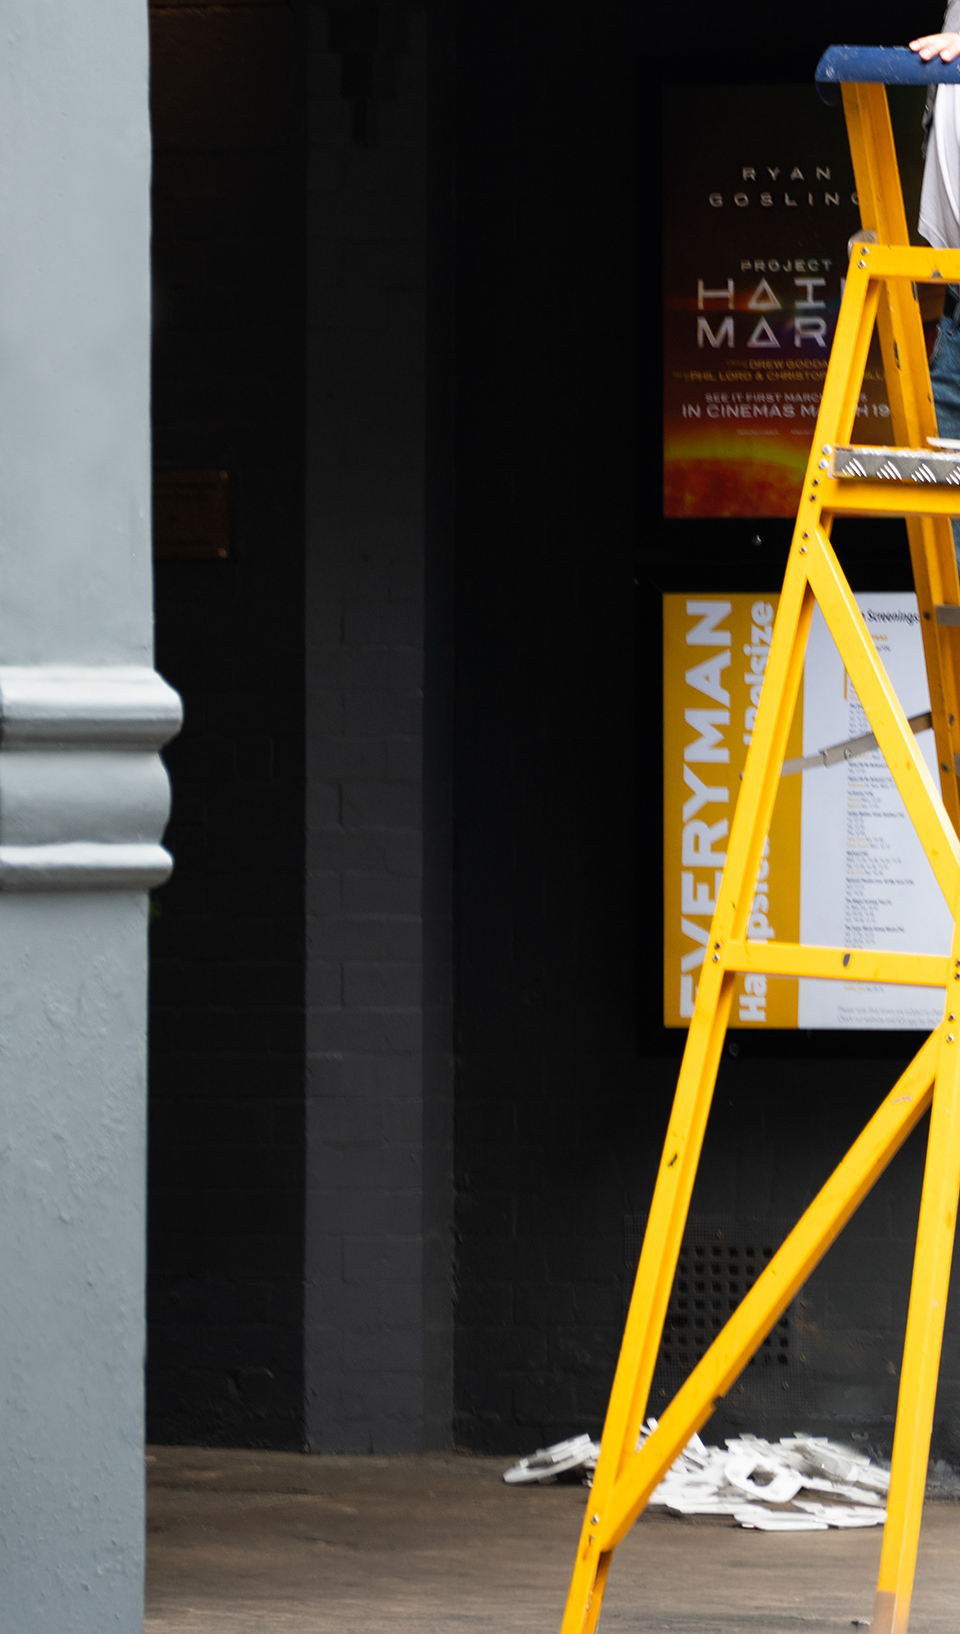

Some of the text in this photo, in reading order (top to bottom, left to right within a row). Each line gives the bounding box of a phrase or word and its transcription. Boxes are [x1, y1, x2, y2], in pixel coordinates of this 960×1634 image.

[741, 165, 832, 182] RYAN
[740, 258, 833, 273] PROJECT
[696, 276, 846, 311] HAI
[696, 315, 829, 350] MAR
[704, 392, 823, 404] SEE IT FIRST MARC
[682, 404, 701, 419] IN
[706, 404, 796, 419] CINEMAS
[872, 403, 891, 419] 19
